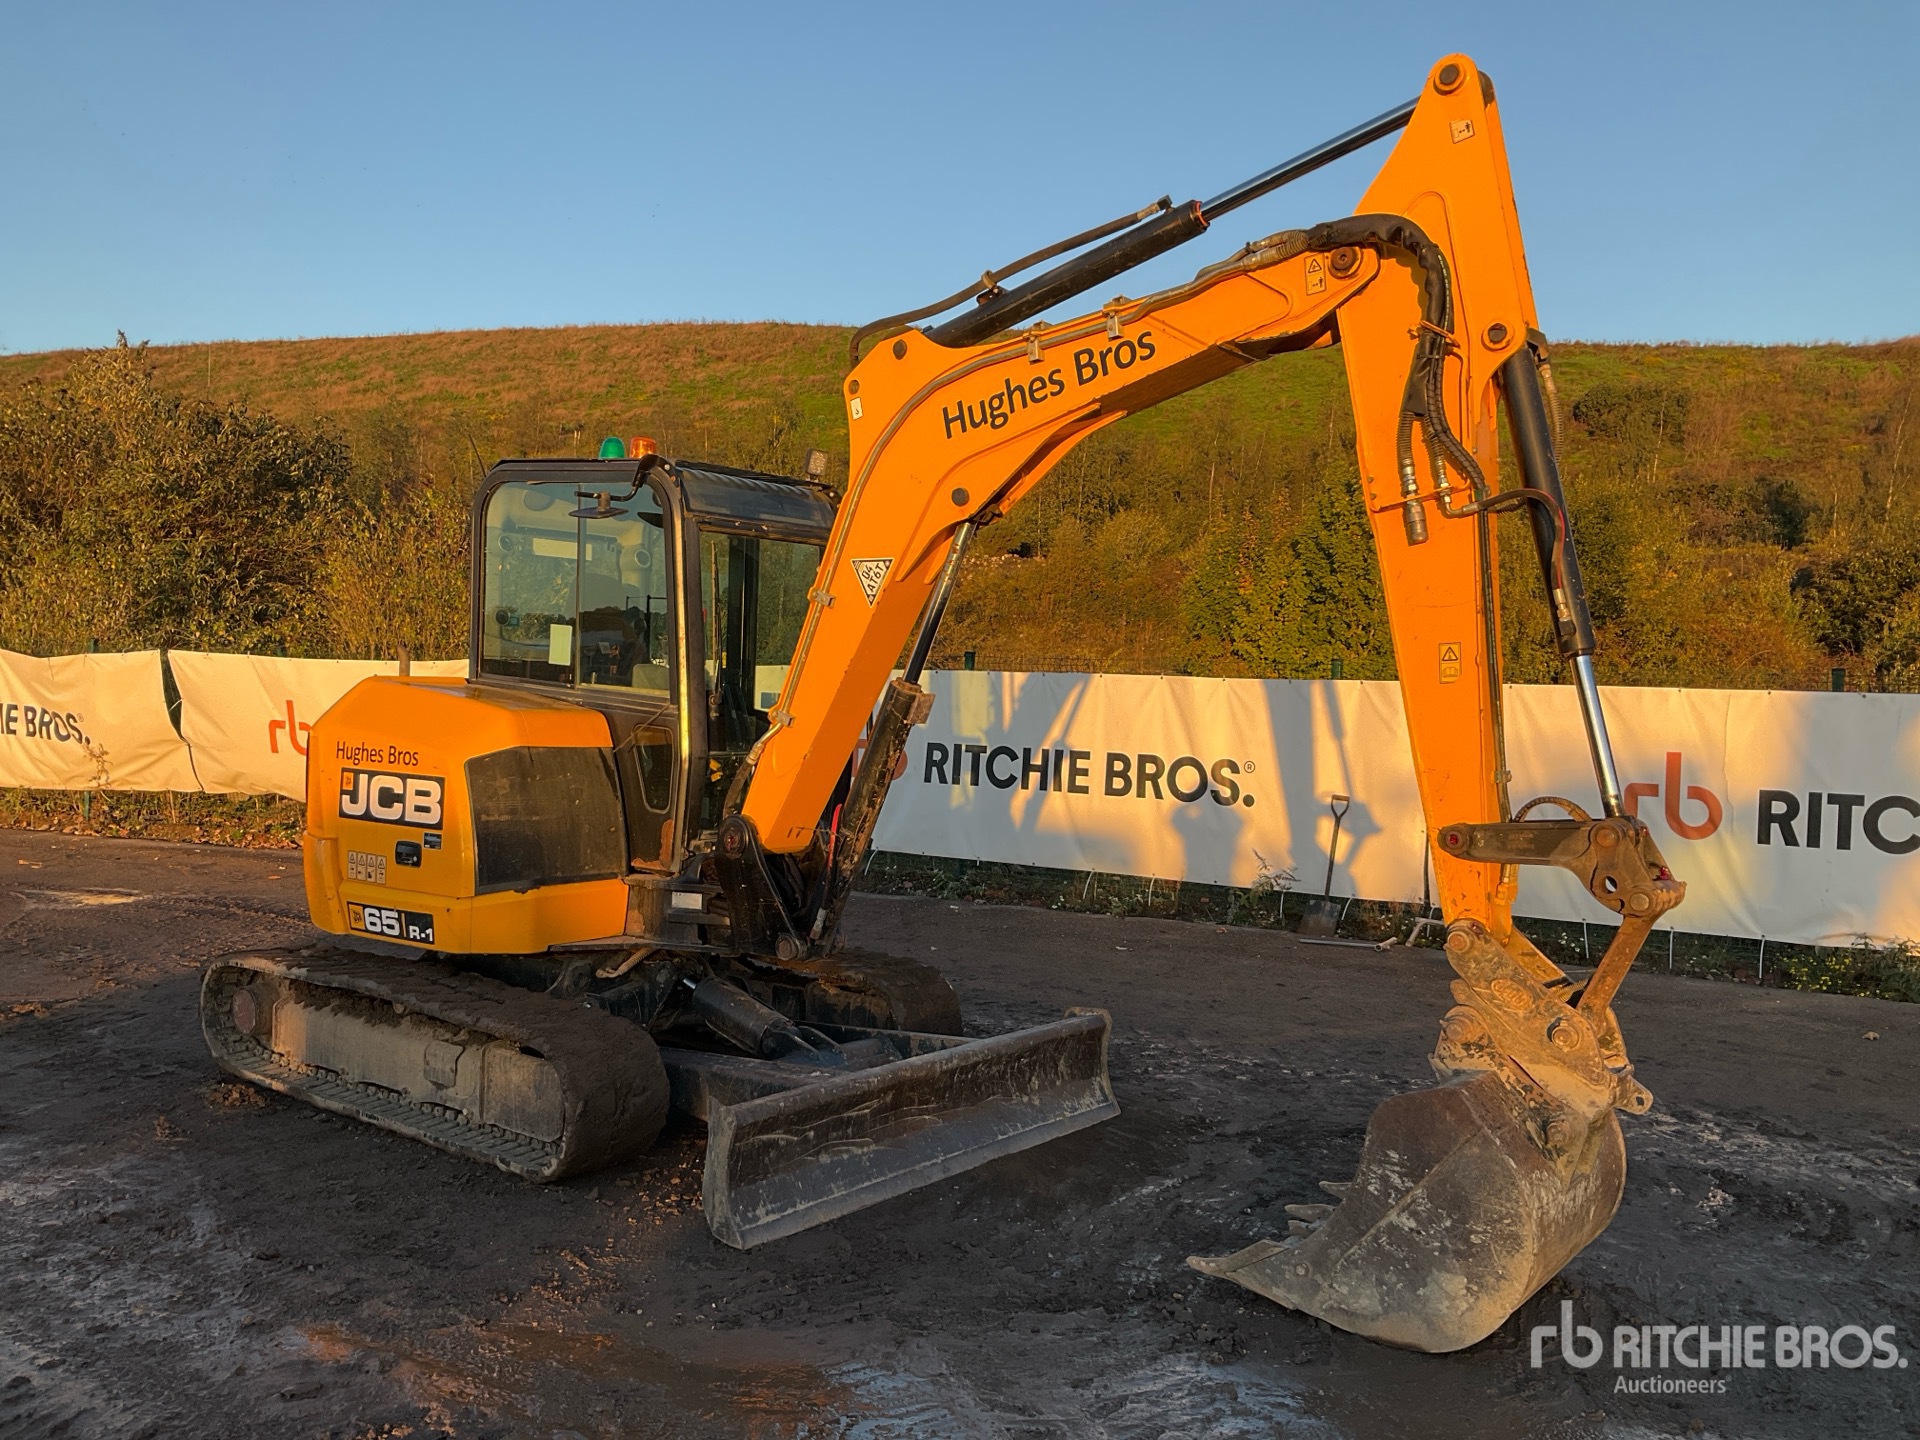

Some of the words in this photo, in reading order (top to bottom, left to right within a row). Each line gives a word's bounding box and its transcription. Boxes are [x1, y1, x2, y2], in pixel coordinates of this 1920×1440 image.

[941, 368, 1065, 439] Hughes
[1073, 330, 1157, 386] Bros
[336, 740, 384, 766] Hughes
[388, 745, 419, 767] Bros
[923, 741, 1091, 795] RITCHIE
[342, 773, 442, 825] JCB
[1757, 789, 1920, 855] RITC
[363, 907, 401, 936] 65
[408, 925, 434, 942] R-1
